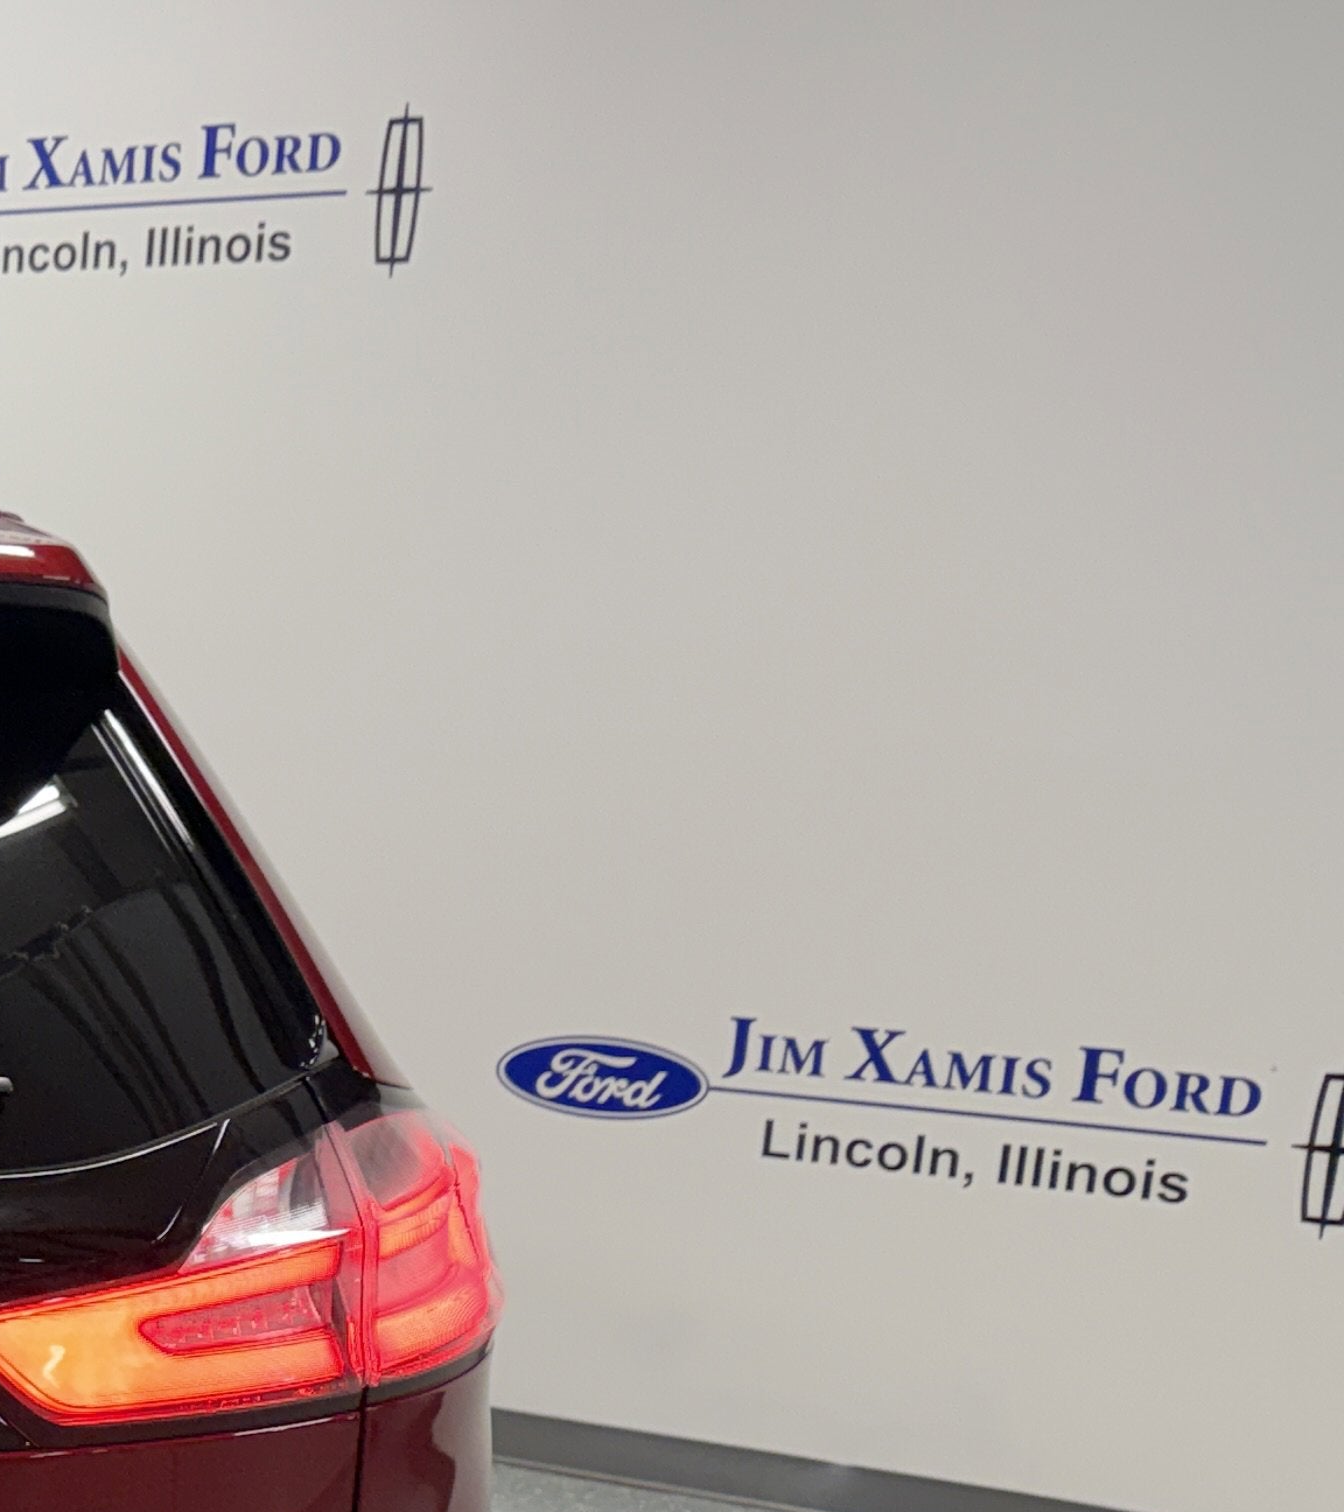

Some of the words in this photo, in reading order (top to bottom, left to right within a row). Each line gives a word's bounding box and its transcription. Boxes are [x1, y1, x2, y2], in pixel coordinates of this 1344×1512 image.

[23, 136, 181, 191] XAMIS
[199, 122, 342, 179] FORD
[145, 223, 291, 267] Illinois
[535, 1048, 667, 1111] Ford
[722, 1017, 830, 1078] JIM
[844, 1026, 1053, 1100] XAMIS
[1071, 1046, 1263, 1118] FORD
[761, 1119, 974, 1187] Lincoln,
[996, 1145, 1189, 1204] Illinois
